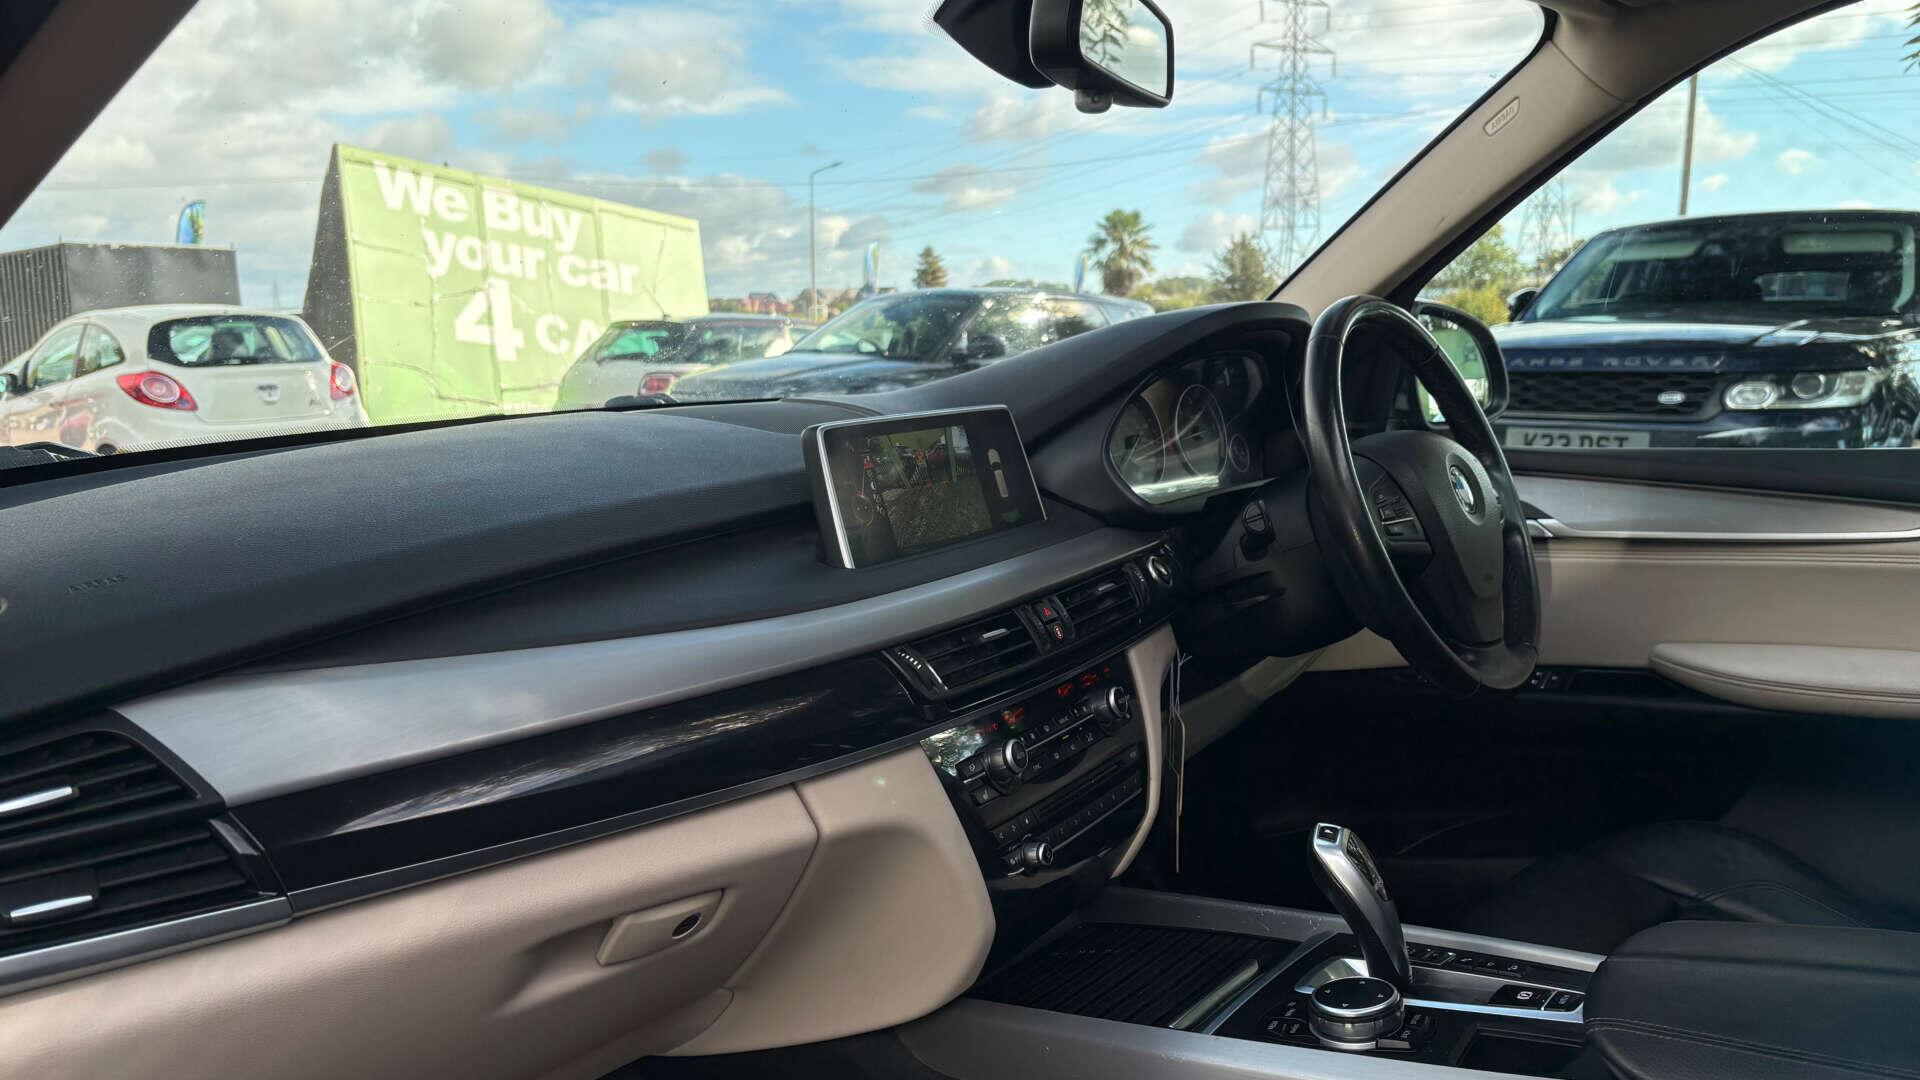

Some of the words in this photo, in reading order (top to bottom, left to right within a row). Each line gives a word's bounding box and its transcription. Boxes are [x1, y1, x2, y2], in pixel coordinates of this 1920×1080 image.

[373, 161, 469, 222] We
[482, 188, 582, 254] Buy
[422, 227, 546, 279] your
[558, 251, 640, 294] car
[454, 277, 524, 363] 4
